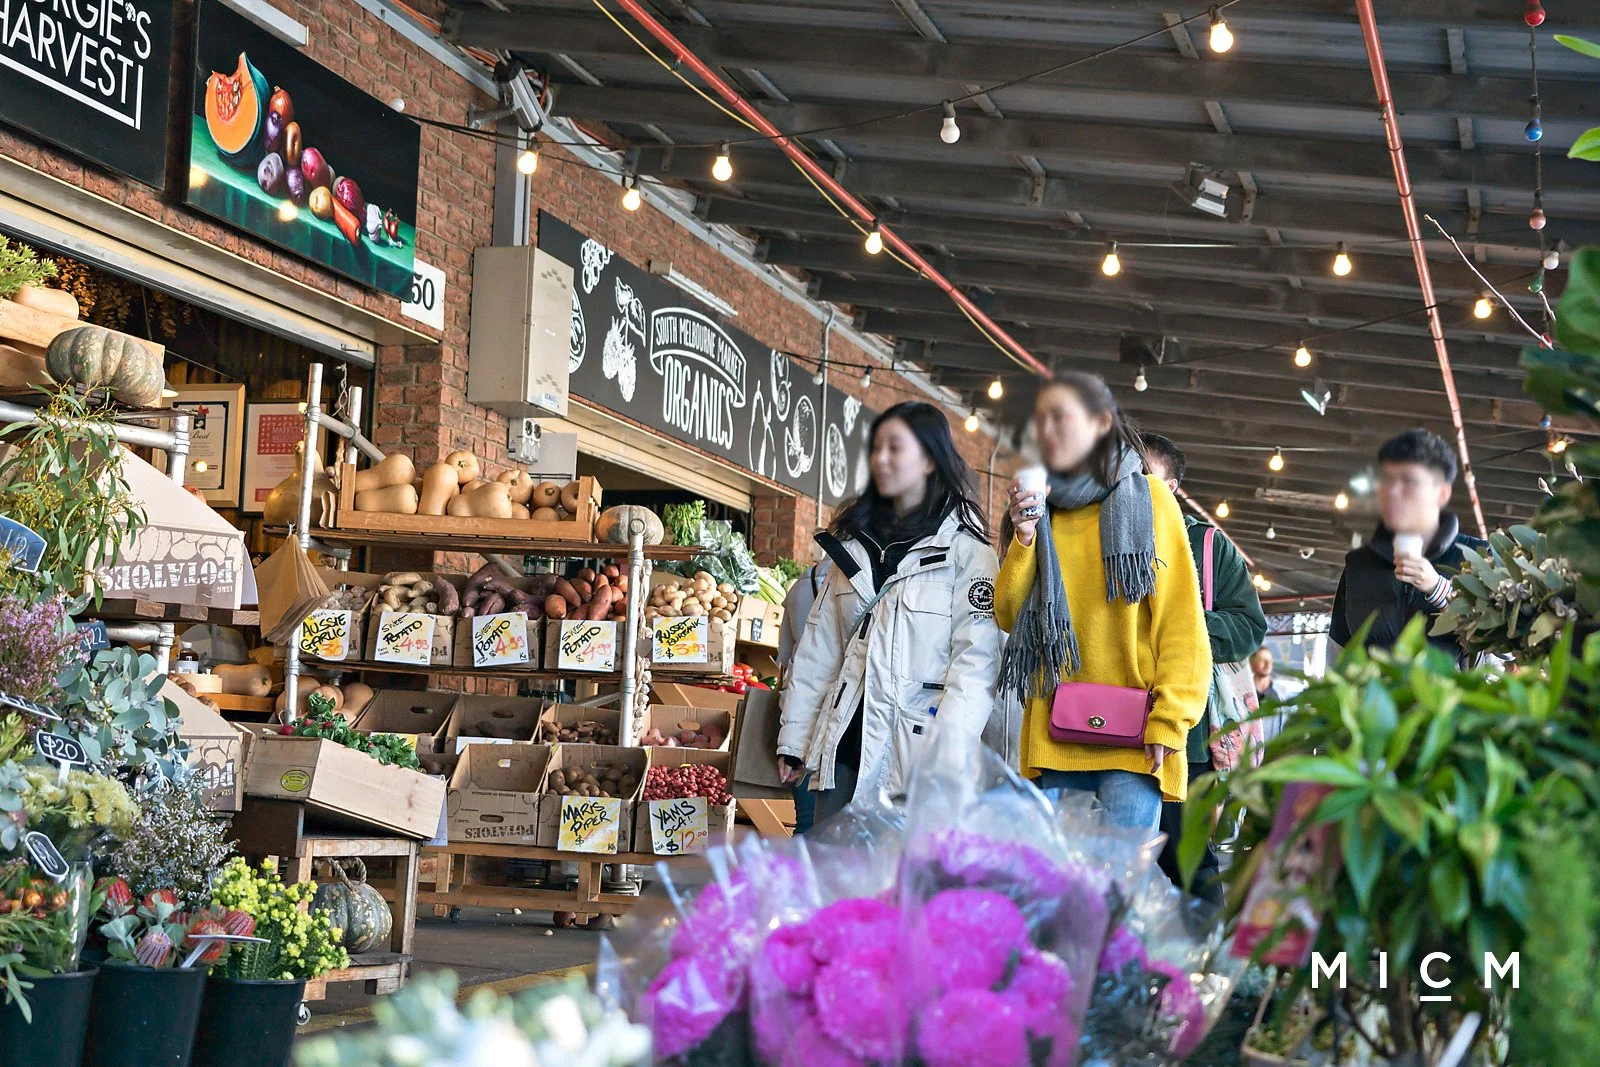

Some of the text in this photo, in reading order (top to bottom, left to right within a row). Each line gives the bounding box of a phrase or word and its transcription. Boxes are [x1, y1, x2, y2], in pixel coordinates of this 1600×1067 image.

[33, 0, 151, 59] GIE'S
[655, 316, 742, 383] SOUTH MELBOURNE MARKET
[663, 355, 734, 450] ORGANICS
[98, 559, 233, 592] POTATOES
[300, 628, 346, 650] GARLIC
[302, 612, 346, 637] AUSSIE
[382, 620, 423, 645] POTATO
[475, 620, 511, 657] POTATO
[562, 626, 601, 656] POTATO
[43, 735, 79, 760] $20
[652, 800, 696, 831] YAMS
[465, 824, 535, 839] POTATOES
